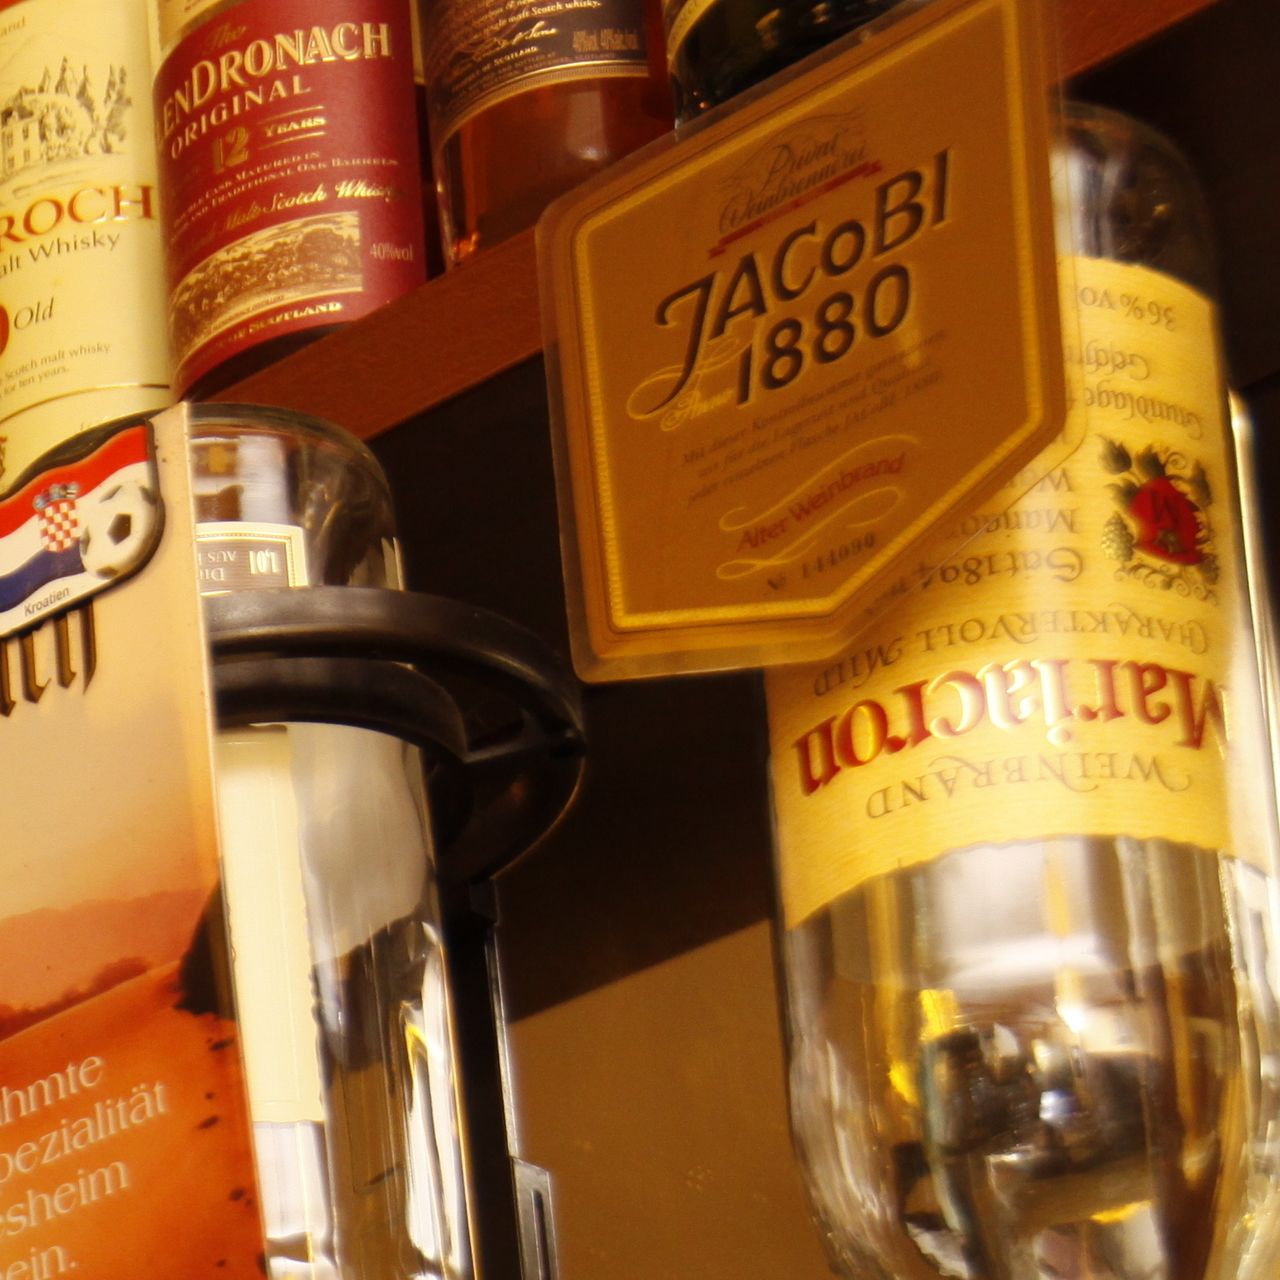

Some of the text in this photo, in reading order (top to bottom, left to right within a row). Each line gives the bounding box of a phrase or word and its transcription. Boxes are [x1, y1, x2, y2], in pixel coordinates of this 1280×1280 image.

[531, 1, 564, 17] Scotch
[171, 74, 313, 160] ORIGINAL
[213, 126, 249, 175] 12
[262, 183, 328, 214] Scotch
[28, 229, 121, 264] Whisky
[14, 297, 55, 331] Old
[737, 262, 911, 406] 1880
[40, 351, 66, 367] malt
[69, 341, 111, 360] whisky
[18, 375, 36, 390] ten
[738, 453, 907, 553] Alter Weinbrand
[22, 586, 73, 618] Kroatien
[920, 607, 1211, 657] CHARAKTERVOLL
[790, 657, 1232, 800] Mariacron
[864, 750, 1193, 820] WEINBRAND
